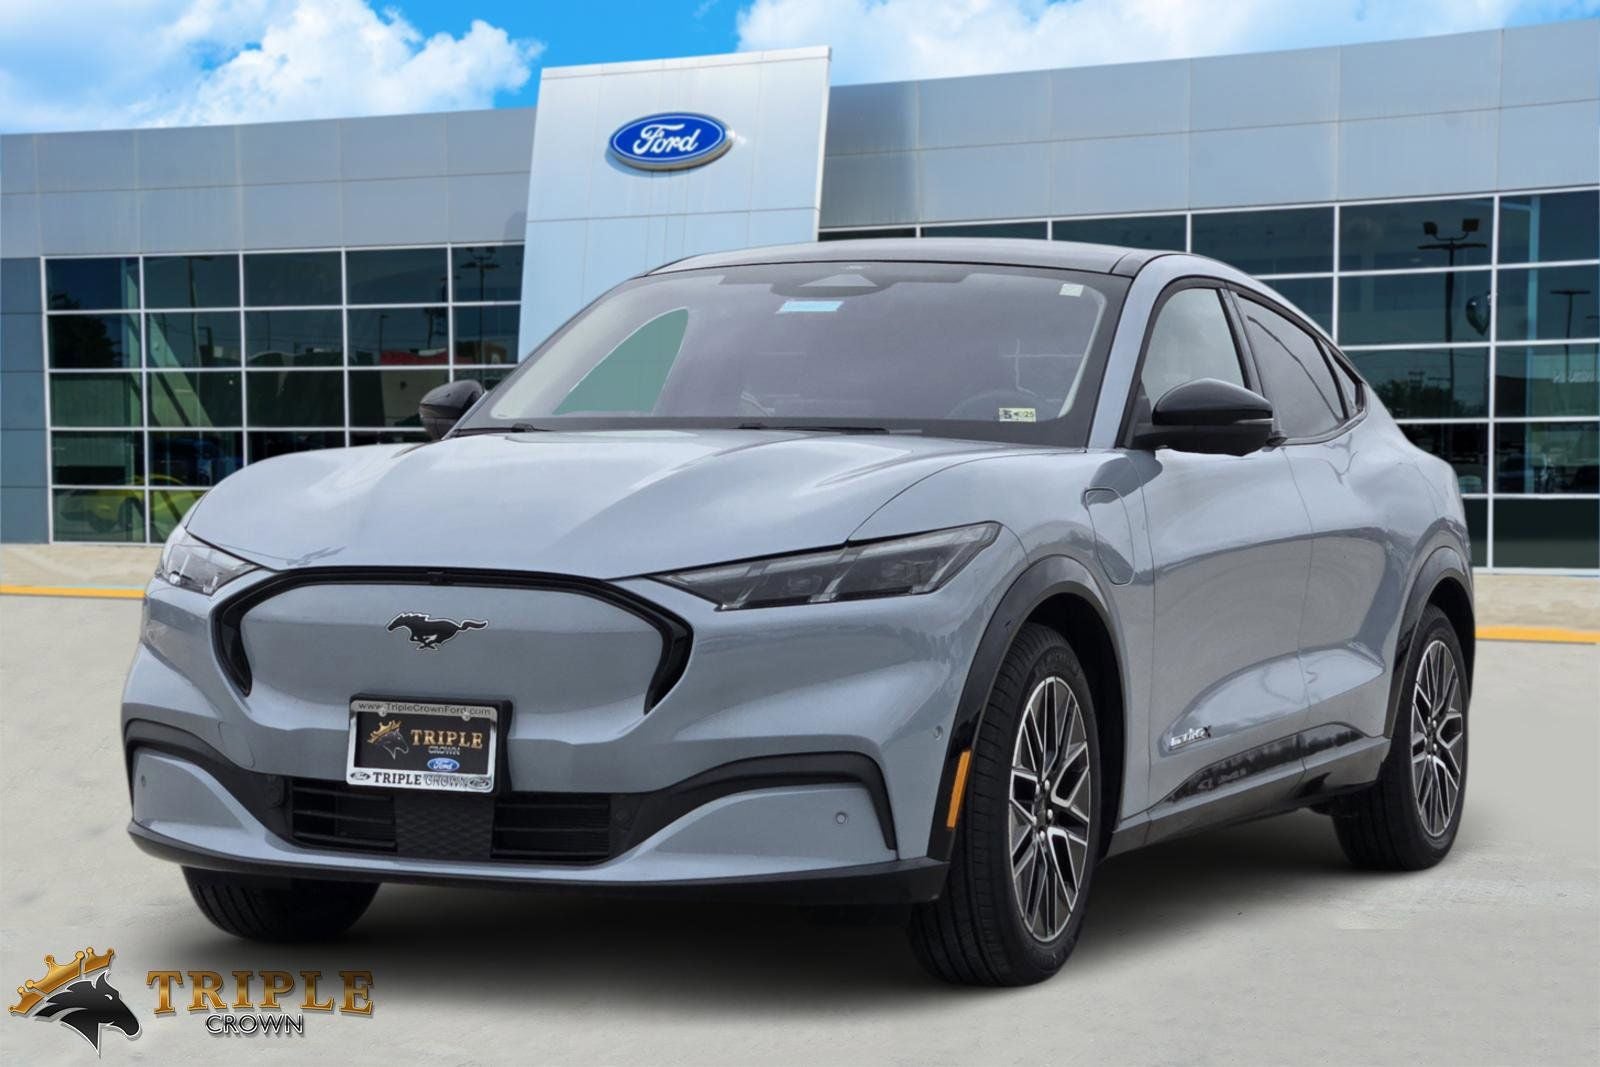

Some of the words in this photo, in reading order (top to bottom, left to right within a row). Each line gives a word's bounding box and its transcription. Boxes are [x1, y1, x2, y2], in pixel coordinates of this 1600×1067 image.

[632, 123, 701, 155] Ford
[358, 703, 492, 715] wwwTripleCrownFordcom
[410, 729, 483, 749] TRIPLE
[372, 771, 422, 786] TRIPLE
